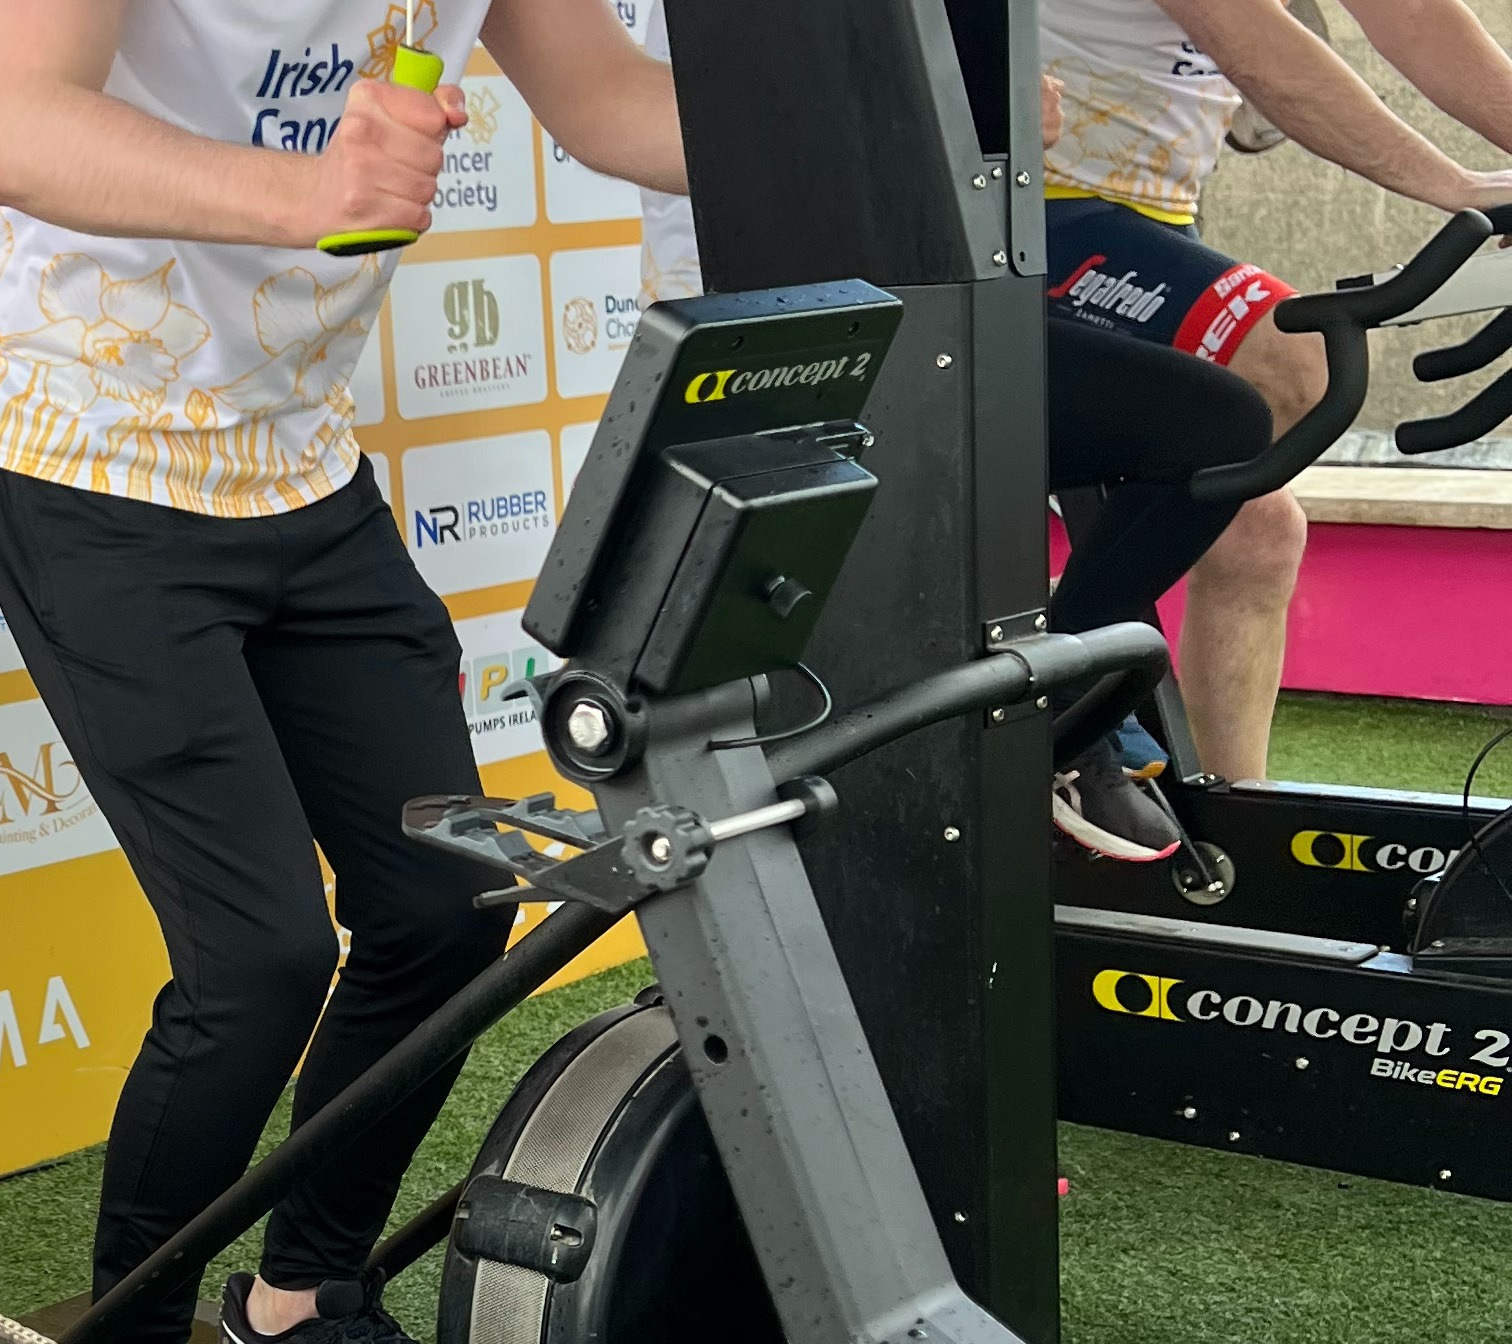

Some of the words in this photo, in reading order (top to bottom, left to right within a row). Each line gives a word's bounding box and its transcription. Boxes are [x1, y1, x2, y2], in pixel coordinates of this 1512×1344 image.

[256, 43, 354, 98] Irish
[433, 180, 498, 211] ociety
[414, 355, 528, 390] GREENBEAN
[730, 357, 849, 396] concept
[850, 352, 871, 379] 2
[468, 490, 547, 522] RUBBER
[416, 506, 461, 548] NR
[468, 514, 549, 540] PRODUCTS
[508, 711, 536, 727] IRELA
[1187, 989, 1452, 1058] concept
[1472, 1029, 1510, 1068] 2
[1370, 1057, 1505, 1096] BikeERG
